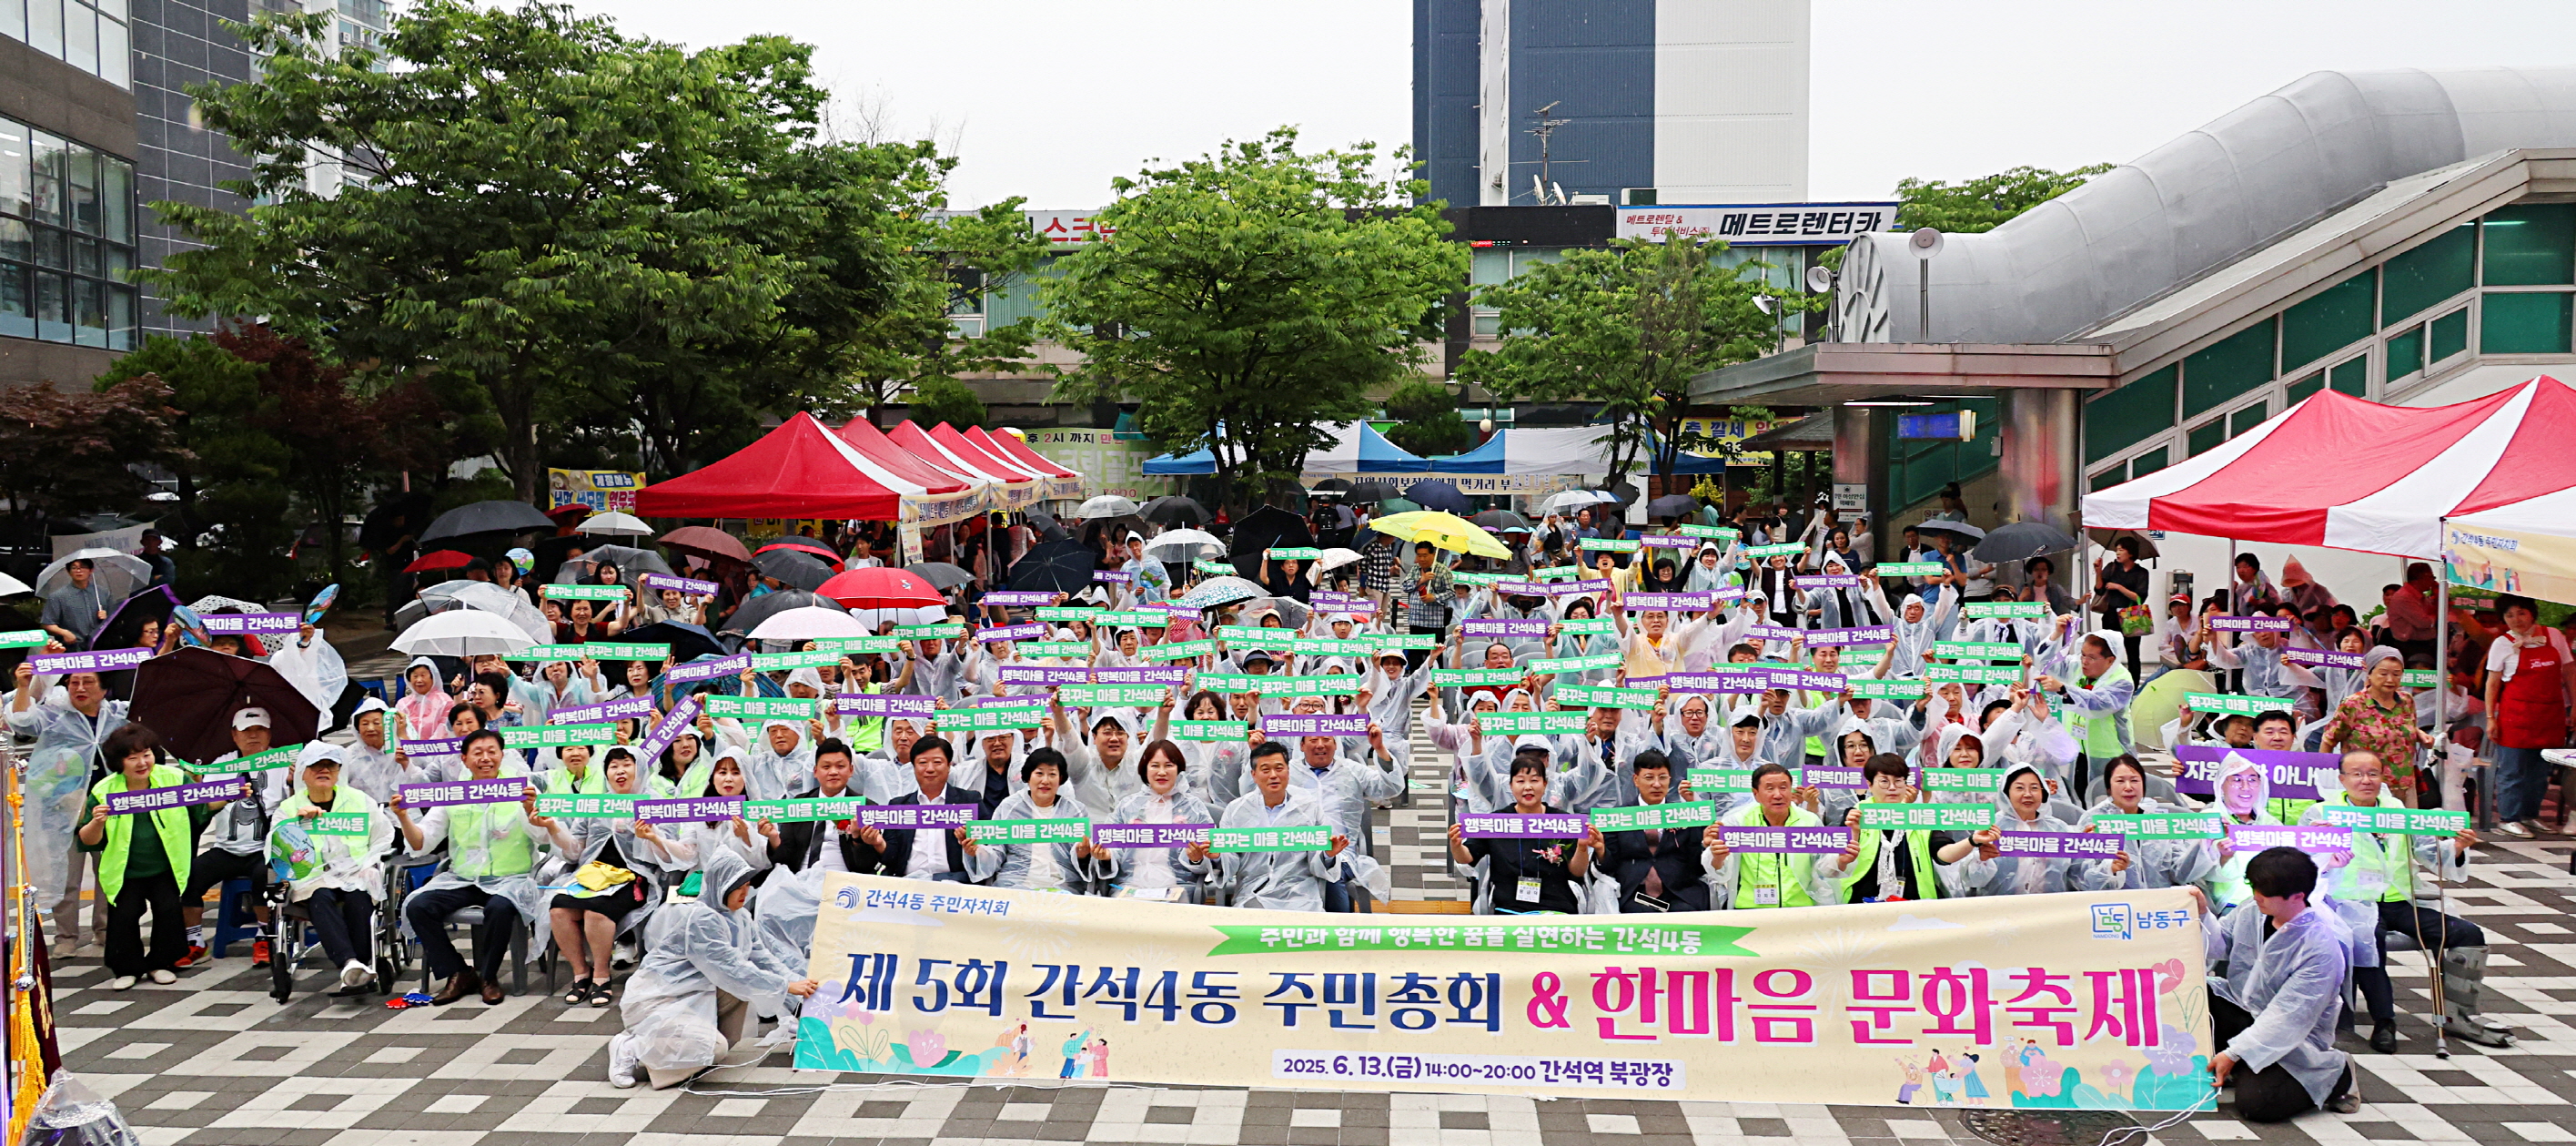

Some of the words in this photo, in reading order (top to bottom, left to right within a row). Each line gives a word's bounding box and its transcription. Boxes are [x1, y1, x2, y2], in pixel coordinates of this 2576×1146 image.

[1627, 214, 1674, 225] 메트로렌탈
[1676, 215, 1682, 224] &
[1719, 212, 1881, 236] 메트로렌터카
[1044, 433, 1064, 443] 2시
[1070, 433, 1095, 444] 까지
[1461, 478, 1495, 491] 먹거리
[646, 575, 684, 589] 행복마을
[685, 581, 716, 593] 간석4동
[1793, 577, 1827, 585] 행복마을
[1828, 576, 1860, 588] 간석4동
[983, 594, 1018, 603] 행복마을
[1020, 593, 1049, 603] 간석4동
[1626, 596, 1668, 607] 행복마을
[1672, 596, 1713, 608] 간석4동
[1465, 623, 1506, 634] 행복마을
[1509, 623, 1546, 634] 간석4동
[2212, 619, 2251, 629] 행복마을
[2254, 620, 2290, 630] 간석4동
[1806, 631, 1850, 644] 행복마을
[1852, 628, 1891, 642] 간석4동
[1935, 644, 1965, 656] 꿈꾸는
[1965, 645, 1985, 656] 마을
[1987, 645, 2025, 657] 간석4동
[2282, 650, 2325, 664] 행복마을
[2327, 654, 2365, 667] 간석4동
[35, 654, 96, 672] 행복마을
[670, 664, 711, 681] 행복마을
[712, 655, 749, 674] 간석4동
[998, 669, 1045, 682] 행복마을
[1047, 671, 1090, 685] 간석4동
[1094, 671, 1141, 685] 행복마을
[1144, 669, 1187, 685] 간석4동
[1430, 672, 1462, 685] 꿈꾸는
[1464, 668, 1484, 684] 마을
[1487, 671, 1522, 683] 간석4동
[1670, 675, 1719, 690] 행복마을
[1722, 676, 1768, 690] 간석4동
[1925, 667, 1959, 680] 꿈꾸는
[1961, 669, 1983, 681] 마을
[1985, 669, 2020, 682] 간석4동
[1261, 681, 1293, 695] 꿈꾸는
[1295, 679, 1317, 693] 마을
[1319, 678, 1361, 692] 간석4동
[1058, 688, 1094, 703] 꿈꾸는
[1096, 688, 1120, 703] 마을
[1124, 688, 1169, 703] 간석4동
[1553, 687, 1589, 703] 꿈꾸는
[1591, 690, 1613, 705] 마을
[1616, 690, 1658, 706] 간석4동
[551, 708, 602, 725] 행복마을
[605, 699, 652, 717] 간석4동
[709, 699, 742, 715] 꿈꾸는
[743, 701, 767, 715] 마을
[770, 702, 811, 716] 간석4동
[833, 697, 887, 713] 행복마을
[890, 699, 939, 714] 간석4동
[936, 714, 971, 728] 꿈꾸는
[974, 712, 997, 726] 마을
[1000, 710, 1046, 725] 간석4동
[1266, 718, 1317, 733] 행복마을
[1320, 718, 1371, 733] 간석4동
[1480, 716, 1515, 731] 꿈꾸는
[1518, 716, 1541, 731] 마을
[1544, 715, 1590, 730] 간석4동
[503, 730, 540, 745] 꿈꾸는
[542, 729, 567, 743] 마을
[570, 727, 613, 742] 간석4동
[112, 790, 178, 811] 행복마을
[182, 782, 240, 802] 간석4동
[404, 786, 465, 804] 행복마을
[469, 782, 523, 800] 간석4동
[638, 803, 690, 820] 행복마을
[693, 800, 745, 817] 간석4동
[747, 805, 784, 822] 꿈꾸는
[787, 802, 813, 818] 마을
[861, 809, 917, 825] 행복마을
[922, 809, 976, 827] 간석4동
[1594, 812, 1633, 829] 꿈꾸는
[1635, 809, 1662, 826] 마을
[1665, 806, 1712, 824] 간석4동
[1864, 808, 1904, 826] 꿈꾸는
[1908, 808, 1936, 826] 마을
[1940, 808, 1991, 826] 간석4동
[1464, 817, 1523, 833] 행복마을
[1529, 818, 1582, 834] 간석4동
[2097, 819, 2138, 835] 꿈꾸는
[2141, 818, 2169, 835] 마을
[2173, 817, 2223, 834] 간석4동
[2327, 810, 2371, 829] 꿈꾸는
[2376, 813, 2406, 829] 마을
[2410, 814, 2465, 832] 간석4동
[970, 825, 1008, 840] 꿈꾸는
[1011, 824, 1036, 839] 마을
[1040, 822, 1086, 839] 간석4동
[1097, 828, 1154, 844] 행복마을
[1213, 832, 1250, 848] 꿈꾸는
[1253, 831, 1278, 847] 마을
[1282, 830, 1328, 847] 간석4동
[1723, 832, 1786, 848] 행복마을
[1792, 832, 1848, 848] 간석4동
[1998, 836, 2059, 853] 행복마을
[2064, 837, 2120, 855] 간석4동
[865, 889, 924, 911] 간석4동
[930, 895, 1010, 916] 주민자치회
[2137, 910, 2190, 929] 남동구
[1260, 928, 1328, 946] 주민과
[1335, 927, 1380, 945] 함께
[1388, 926, 1457, 948] 행복한
[1465, 926, 1506, 948] 꿈을
[1512, 926, 1605, 952] 실현하는
[1611, 927, 1702, 955] 간석4동
[837, 951, 895, 1012] 제
[912, 958, 1008, 1014] 5회
[1024, 962, 1241, 1026] 간석4동
[1262, 971, 1501, 1032] 주민총회
[1527, 971, 1571, 1030] &
[1590, 966, 1821, 1045] 한마음
[1845, 966, 2162, 1047] 문화축제
[1283, 1058, 1328, 1074] 2025.
[1425, 1062, 1536, 1080] 14:00~20:00
[1540, 1060, 1604, 1083] 간석역
[1610, 1061, 1672, 1087] 북광장
